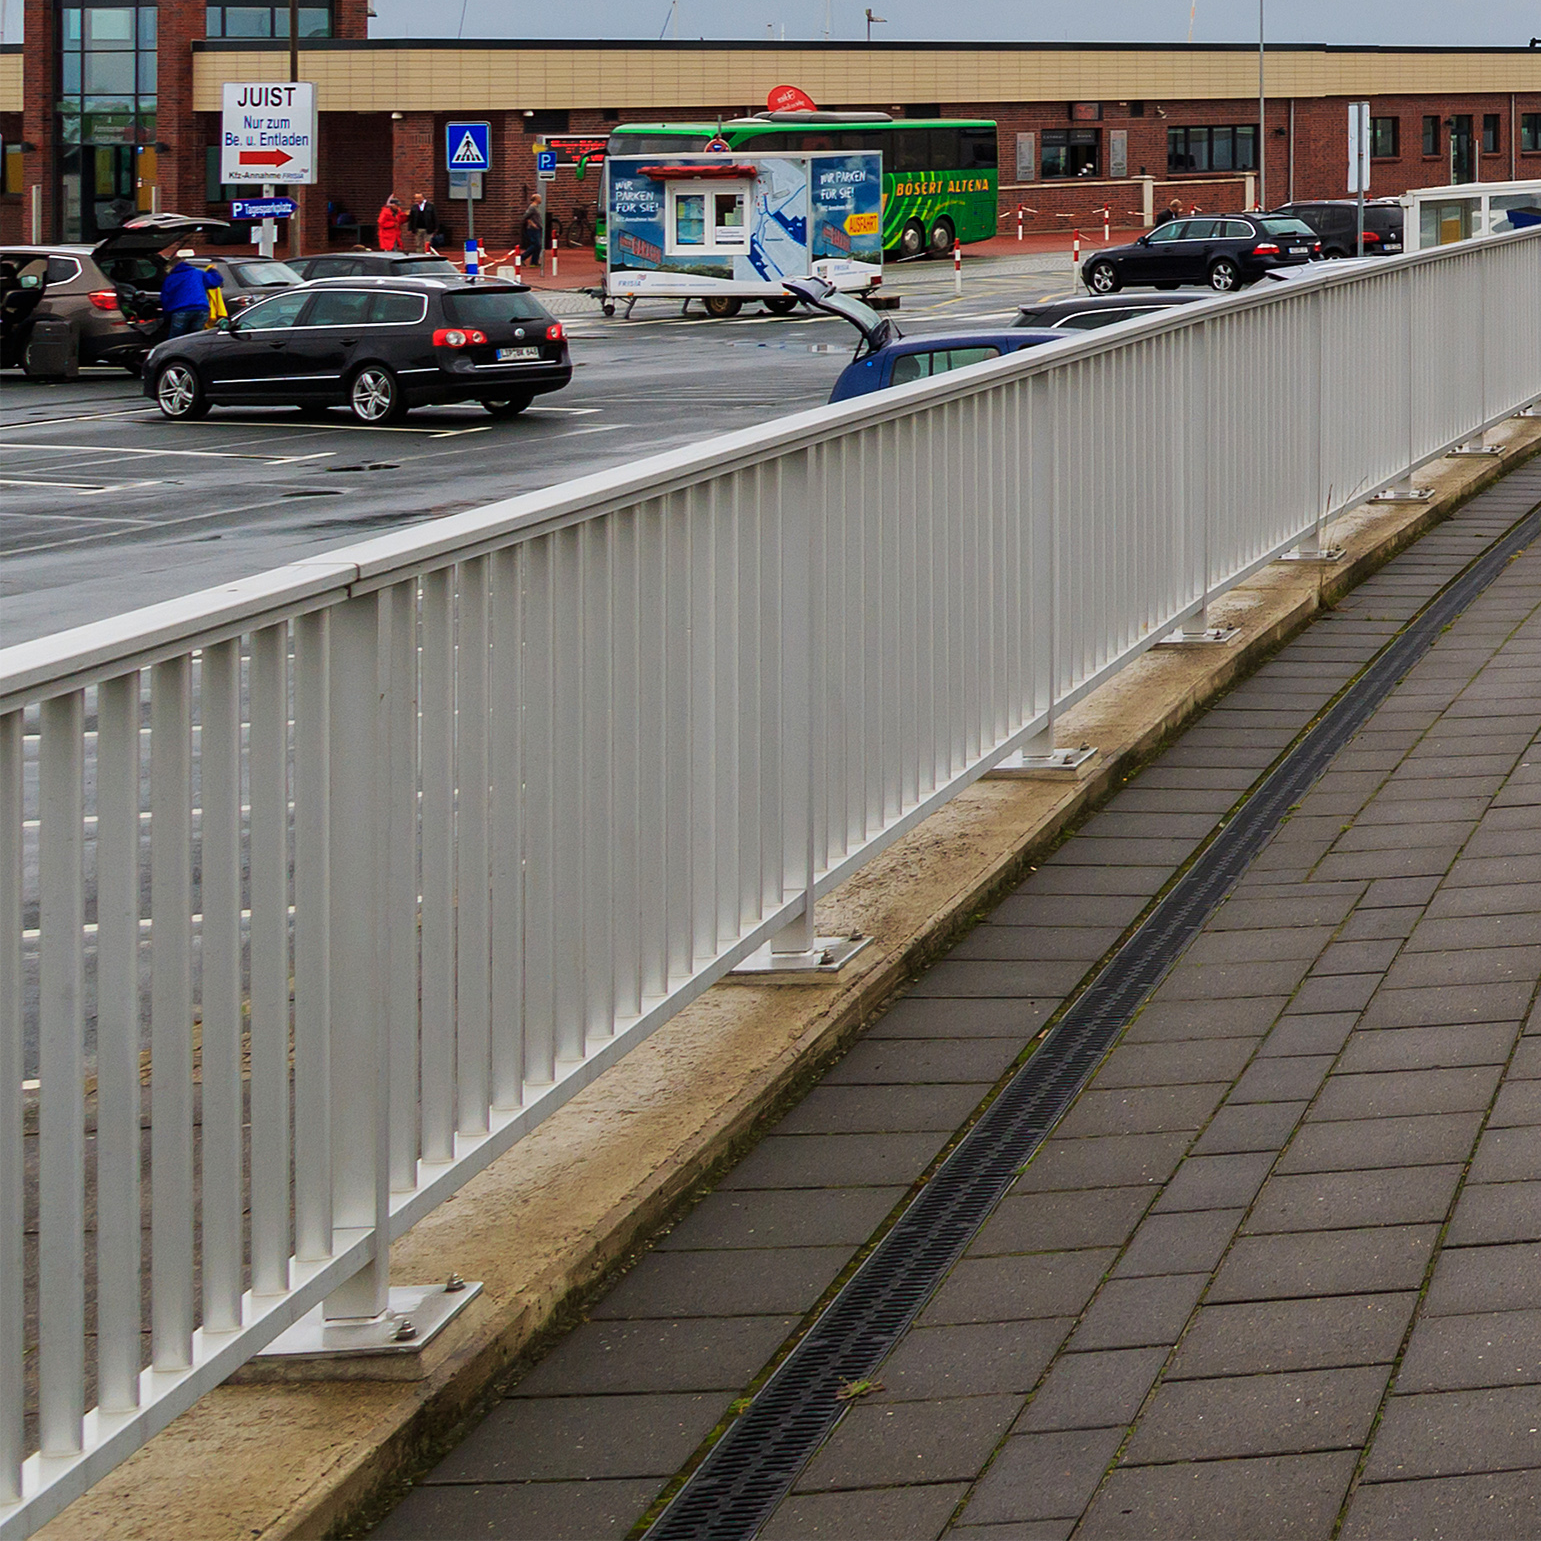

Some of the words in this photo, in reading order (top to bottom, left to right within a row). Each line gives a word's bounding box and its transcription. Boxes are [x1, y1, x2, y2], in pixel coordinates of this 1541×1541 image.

[237, 87, 296, 107] JUIST
[244, 115, 264, 129] Nur
[267, 118, 290, 129] zum
[225, 132, 243, 146] Be.
[246, 135, 256, 146] u.
[260, 132, 309, 146] Entladen
[541, 154, 551, 168] P
[820, 174, 834, 184] WIR
[836, 171, 866, 183] PARKEN
[615, 180, 633, 190] WIR
[896, 179, 943, 196] BÖSERT
[947, 179, 989, 193] ALTENA
[616, 191, 654, 201] PARKEN
[821, 188, 837, 199] FÜR
[839, 187, 854, 198] SIE!
[232, 202, 243, 217] P
[616, 202, 637, 212] FÜR
[640, 202, 659, 212] SIE!
[849, 215, 878, 233] AUSFAHRT
